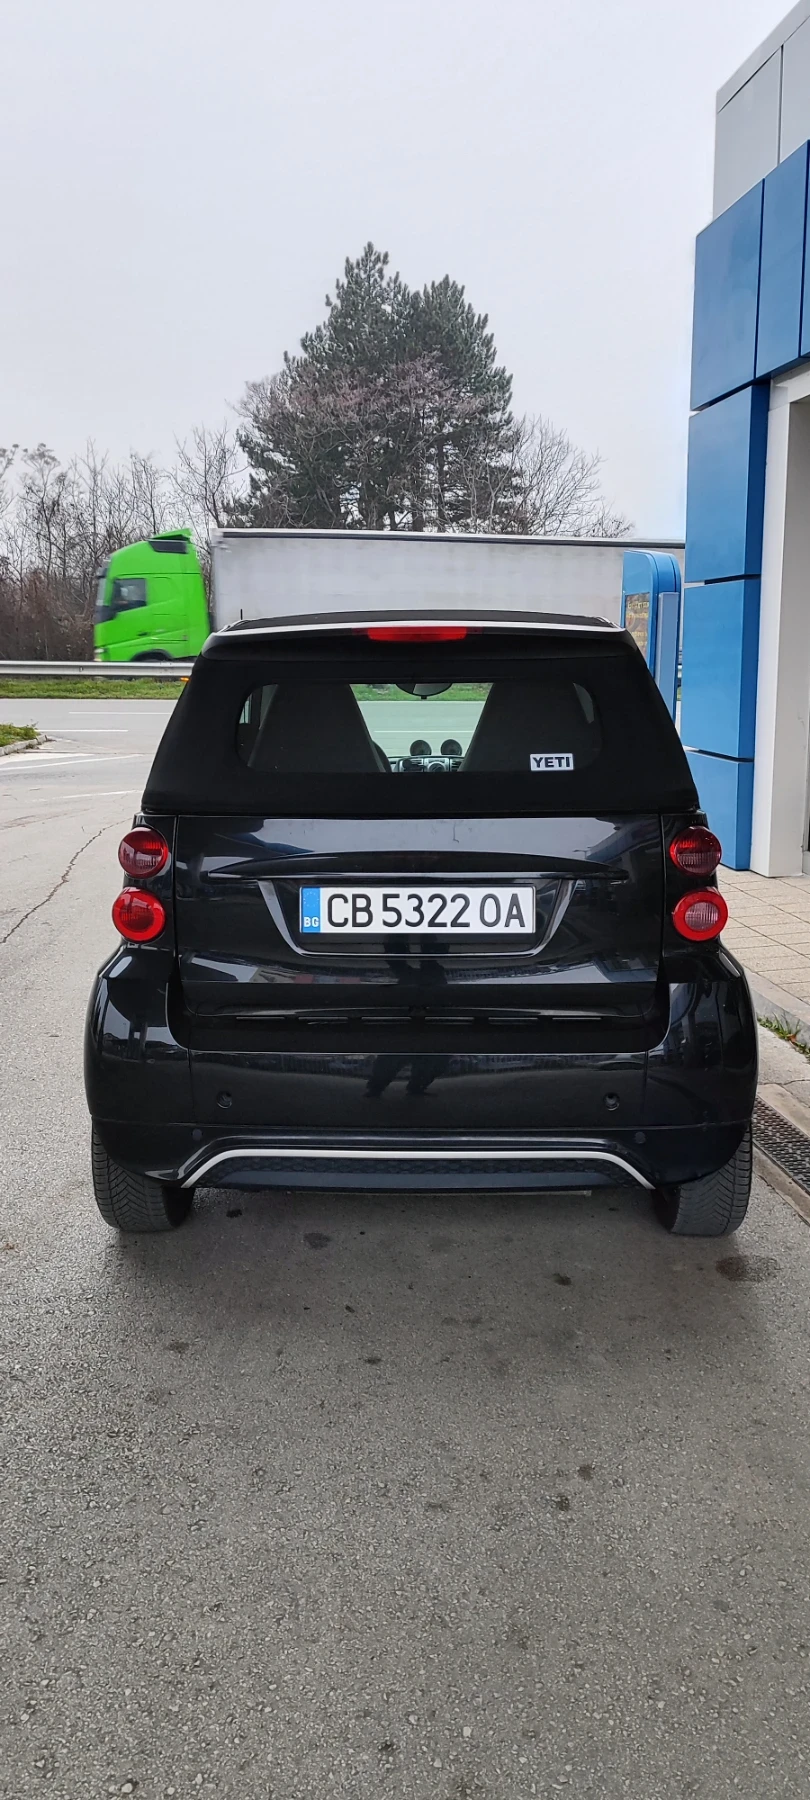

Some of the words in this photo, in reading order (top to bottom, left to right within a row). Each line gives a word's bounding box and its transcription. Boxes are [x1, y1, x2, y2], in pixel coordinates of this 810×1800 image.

[532, 756, 571, 768] YETI
[327, 893, 373, 928] CB
[382, 893, 470, 928] 5322
[479, 893, 525, 928] OA
[303, 917, 320, 928] BG
